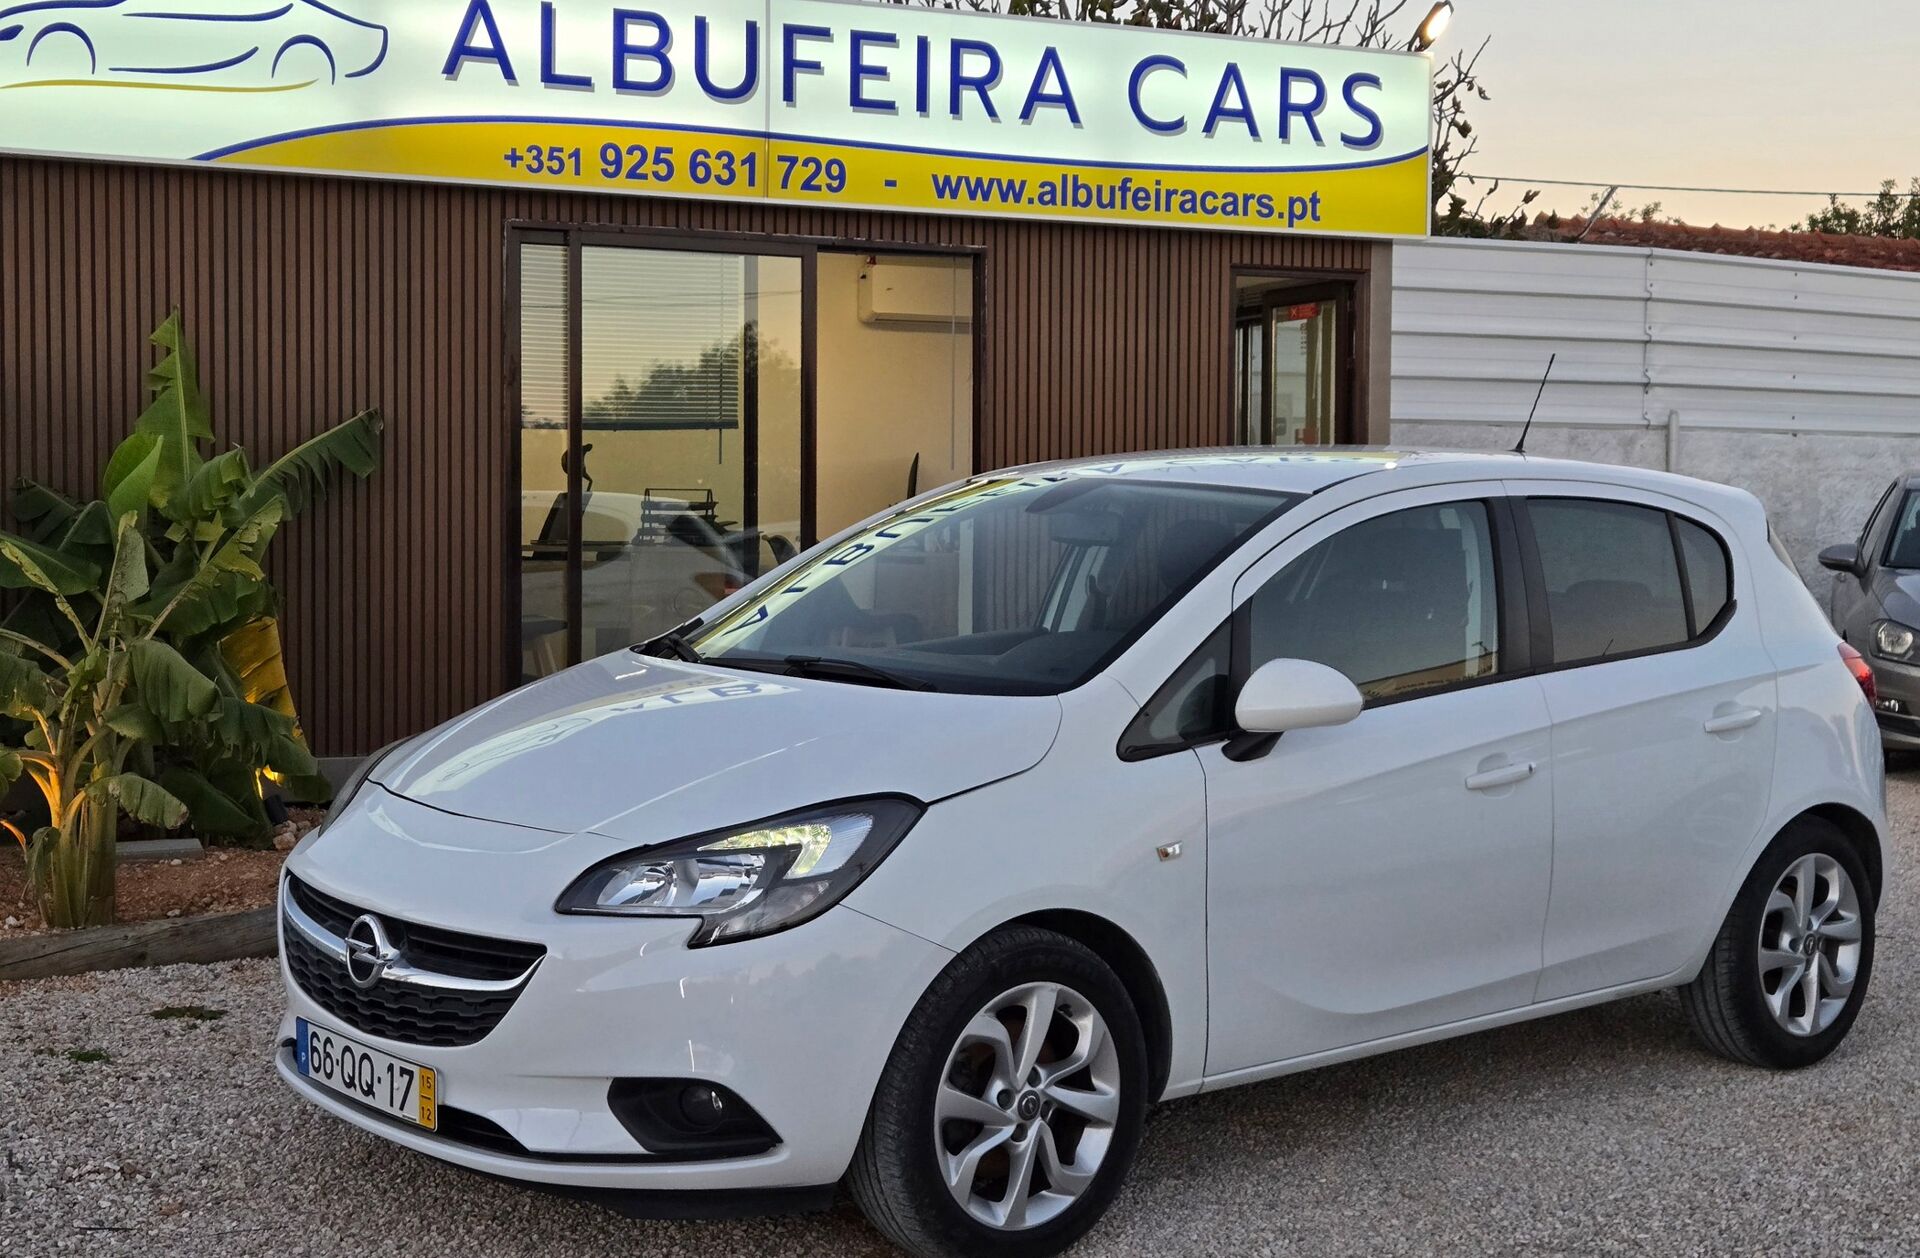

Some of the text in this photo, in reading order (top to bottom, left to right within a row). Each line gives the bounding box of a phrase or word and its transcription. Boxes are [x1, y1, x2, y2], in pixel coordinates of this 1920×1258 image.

[441, 0, 1382, 148] ALBUFEIRA CARS
[504, 145, 581, 176] +351
[600, 142, 675, 182] 925
[689, 149, 757, 187] 631
[776, 155, 847, 193] 729
[932, 174, 1321, 228] www.albufeiracars.pt
[421, 1074, 432, 1090] 15
[421, 1105, 432, 1122] 12
